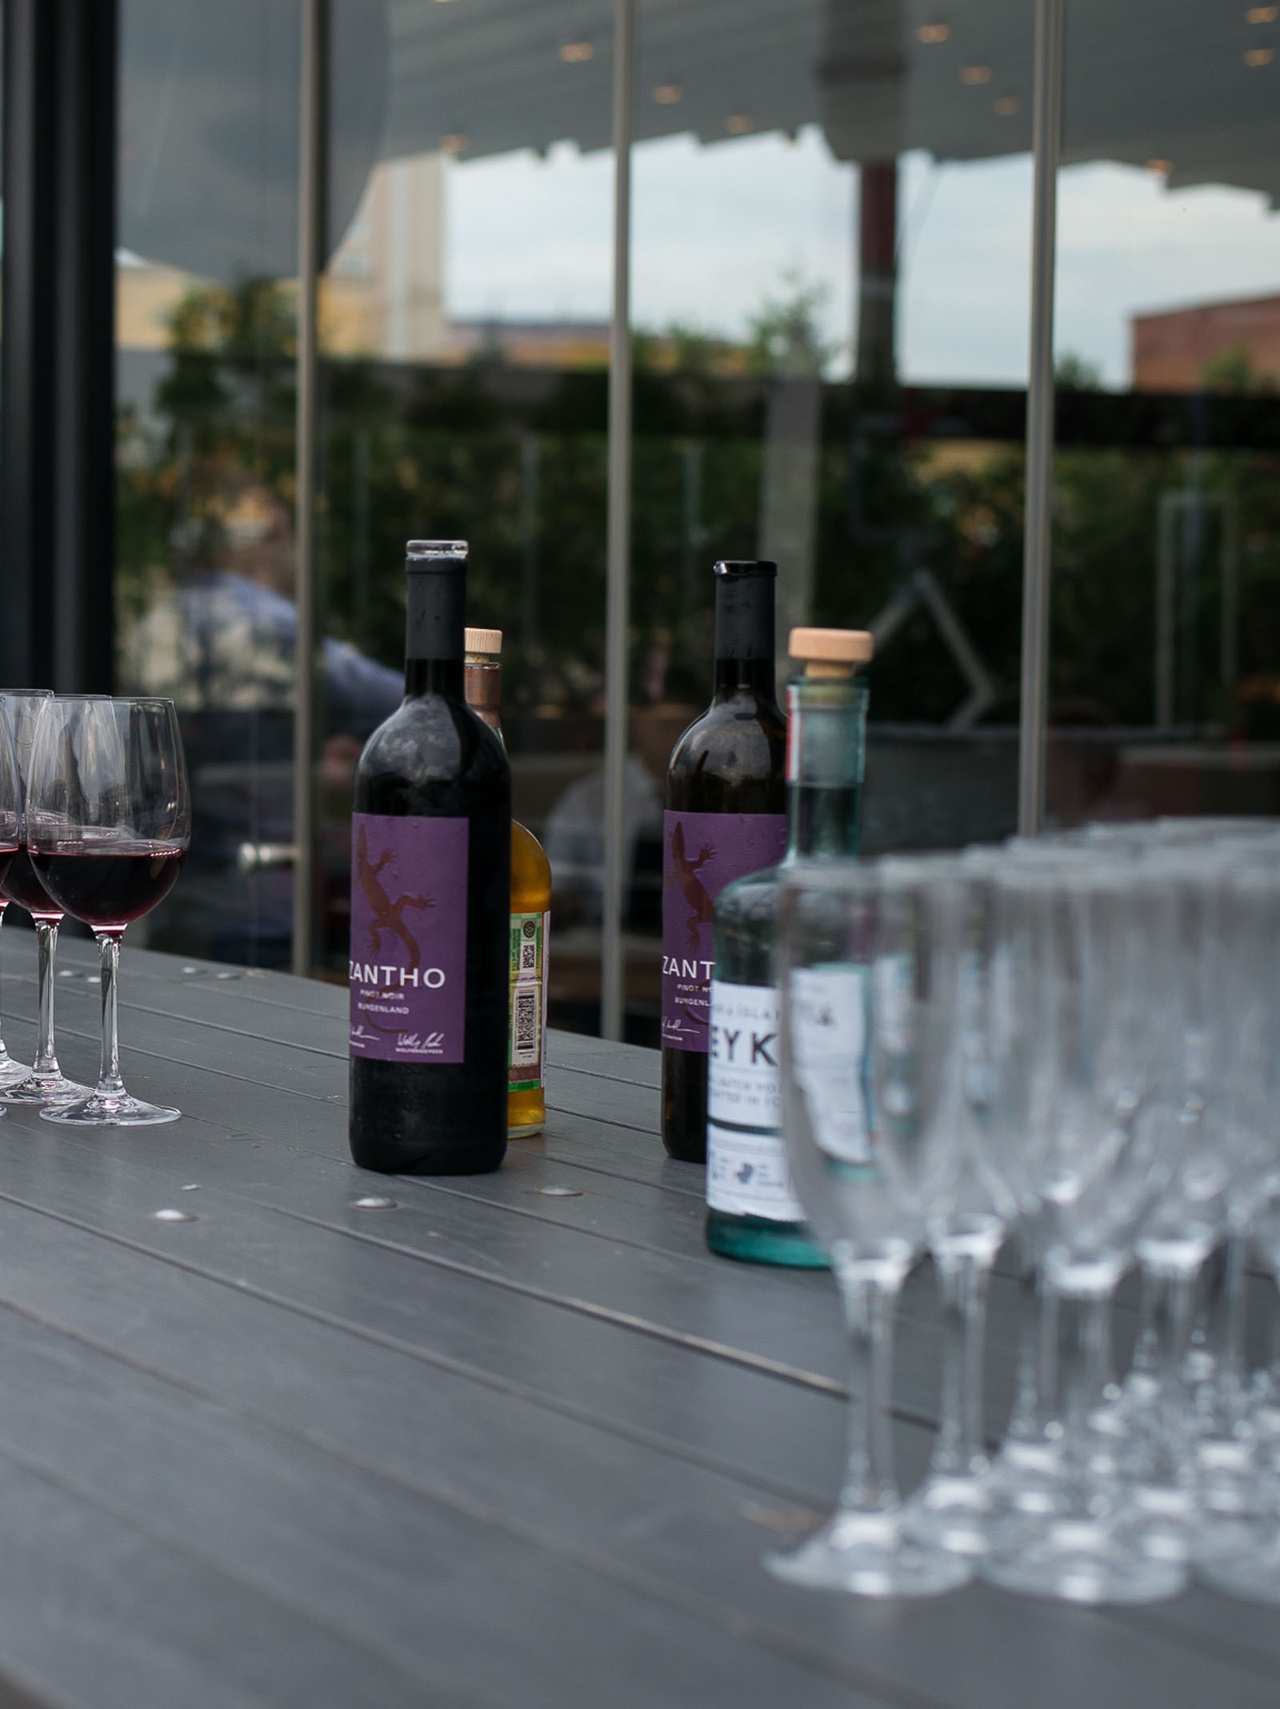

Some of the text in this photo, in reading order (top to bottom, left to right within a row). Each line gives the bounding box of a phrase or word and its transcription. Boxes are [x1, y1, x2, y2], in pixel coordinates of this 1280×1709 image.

[349, 960, 446, 989] ZANTHO
[677, 983, 699, 993] PINOT
[382, 991, 405, 1000] NOIR
[674, 996, 713, 1007] BURGENL
[357, 1002, 410, 1015] BURGENLAND
